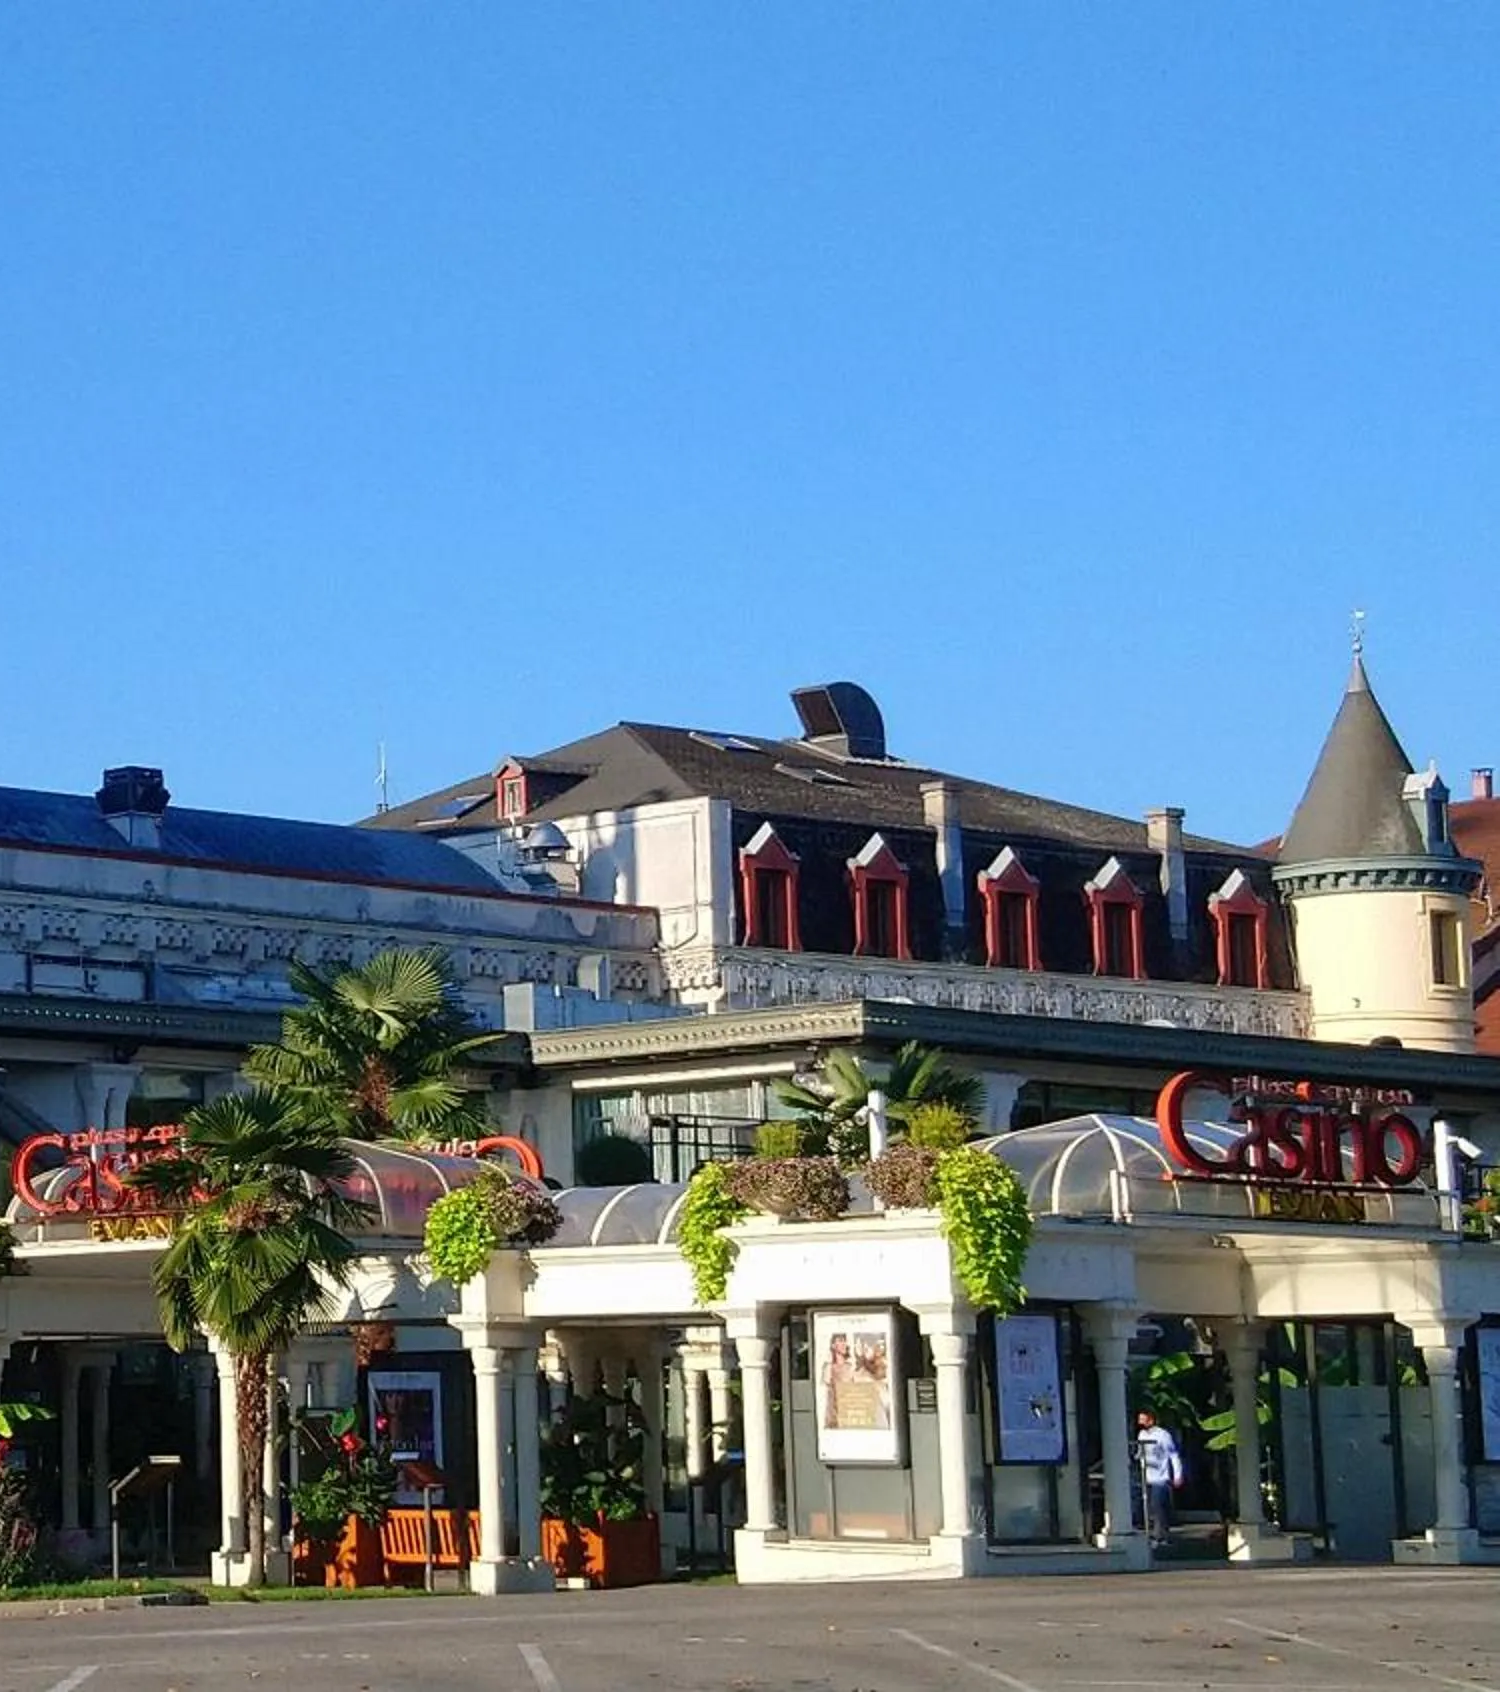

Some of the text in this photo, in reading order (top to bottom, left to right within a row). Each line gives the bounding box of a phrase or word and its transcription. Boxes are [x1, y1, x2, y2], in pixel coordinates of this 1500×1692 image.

[69, 1127, 128, 1150] plus
[1156, 1070, 1421, 1186] Casino
[88, 1214, 174, 1242] EVIAN
